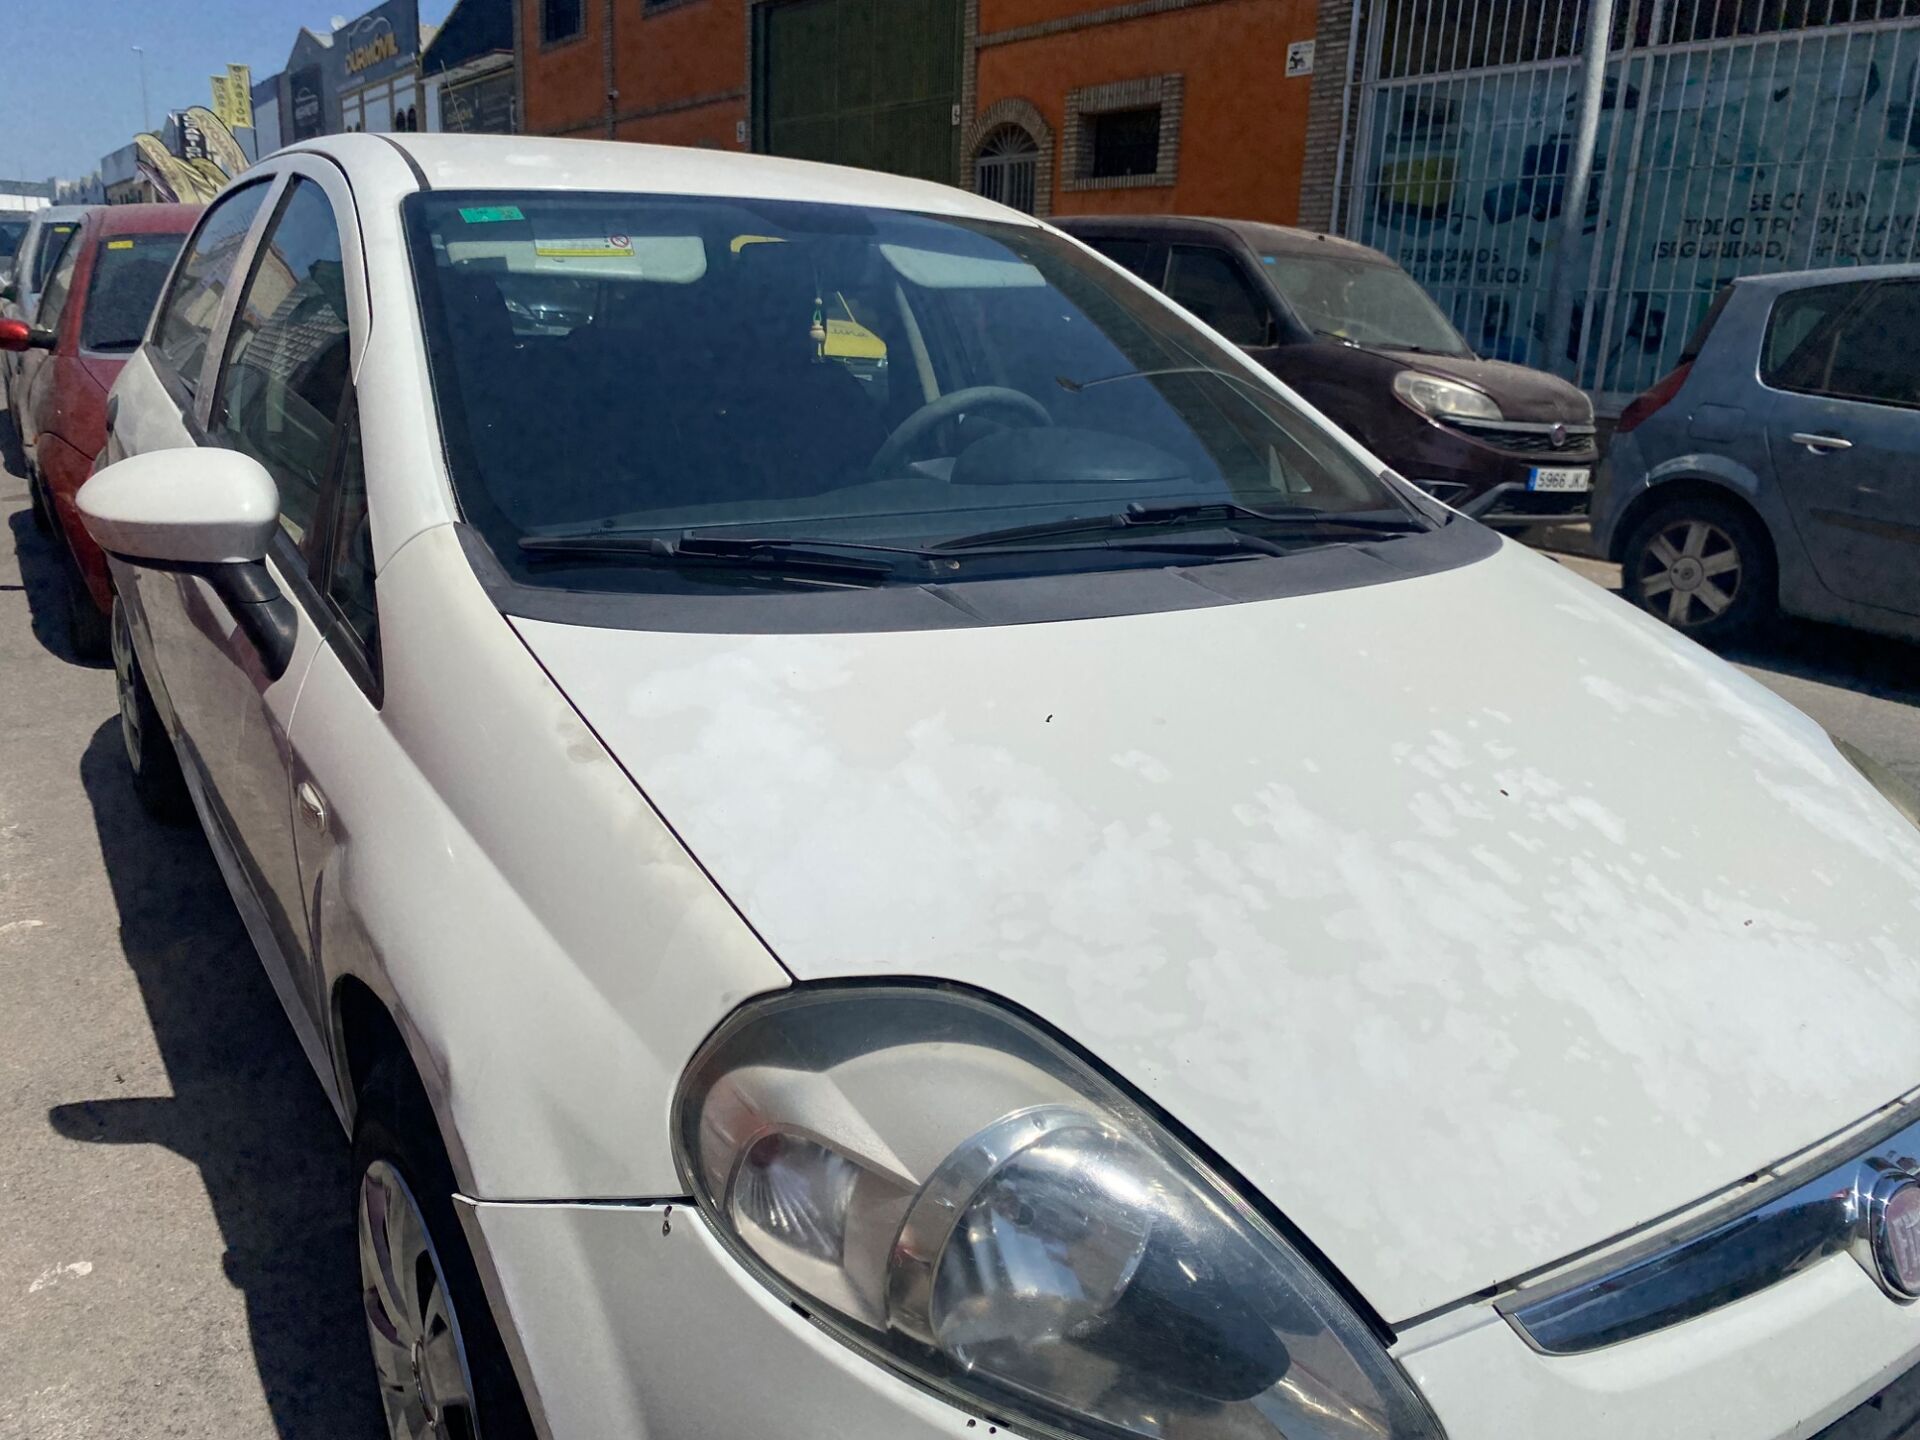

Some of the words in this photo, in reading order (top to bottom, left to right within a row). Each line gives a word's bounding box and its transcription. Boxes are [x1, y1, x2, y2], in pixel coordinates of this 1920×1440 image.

[1750, 193, 1772, 212] SE
[1683, 216, 1746, 237] TODO
[1538, 471, 1567, 489] 5966
